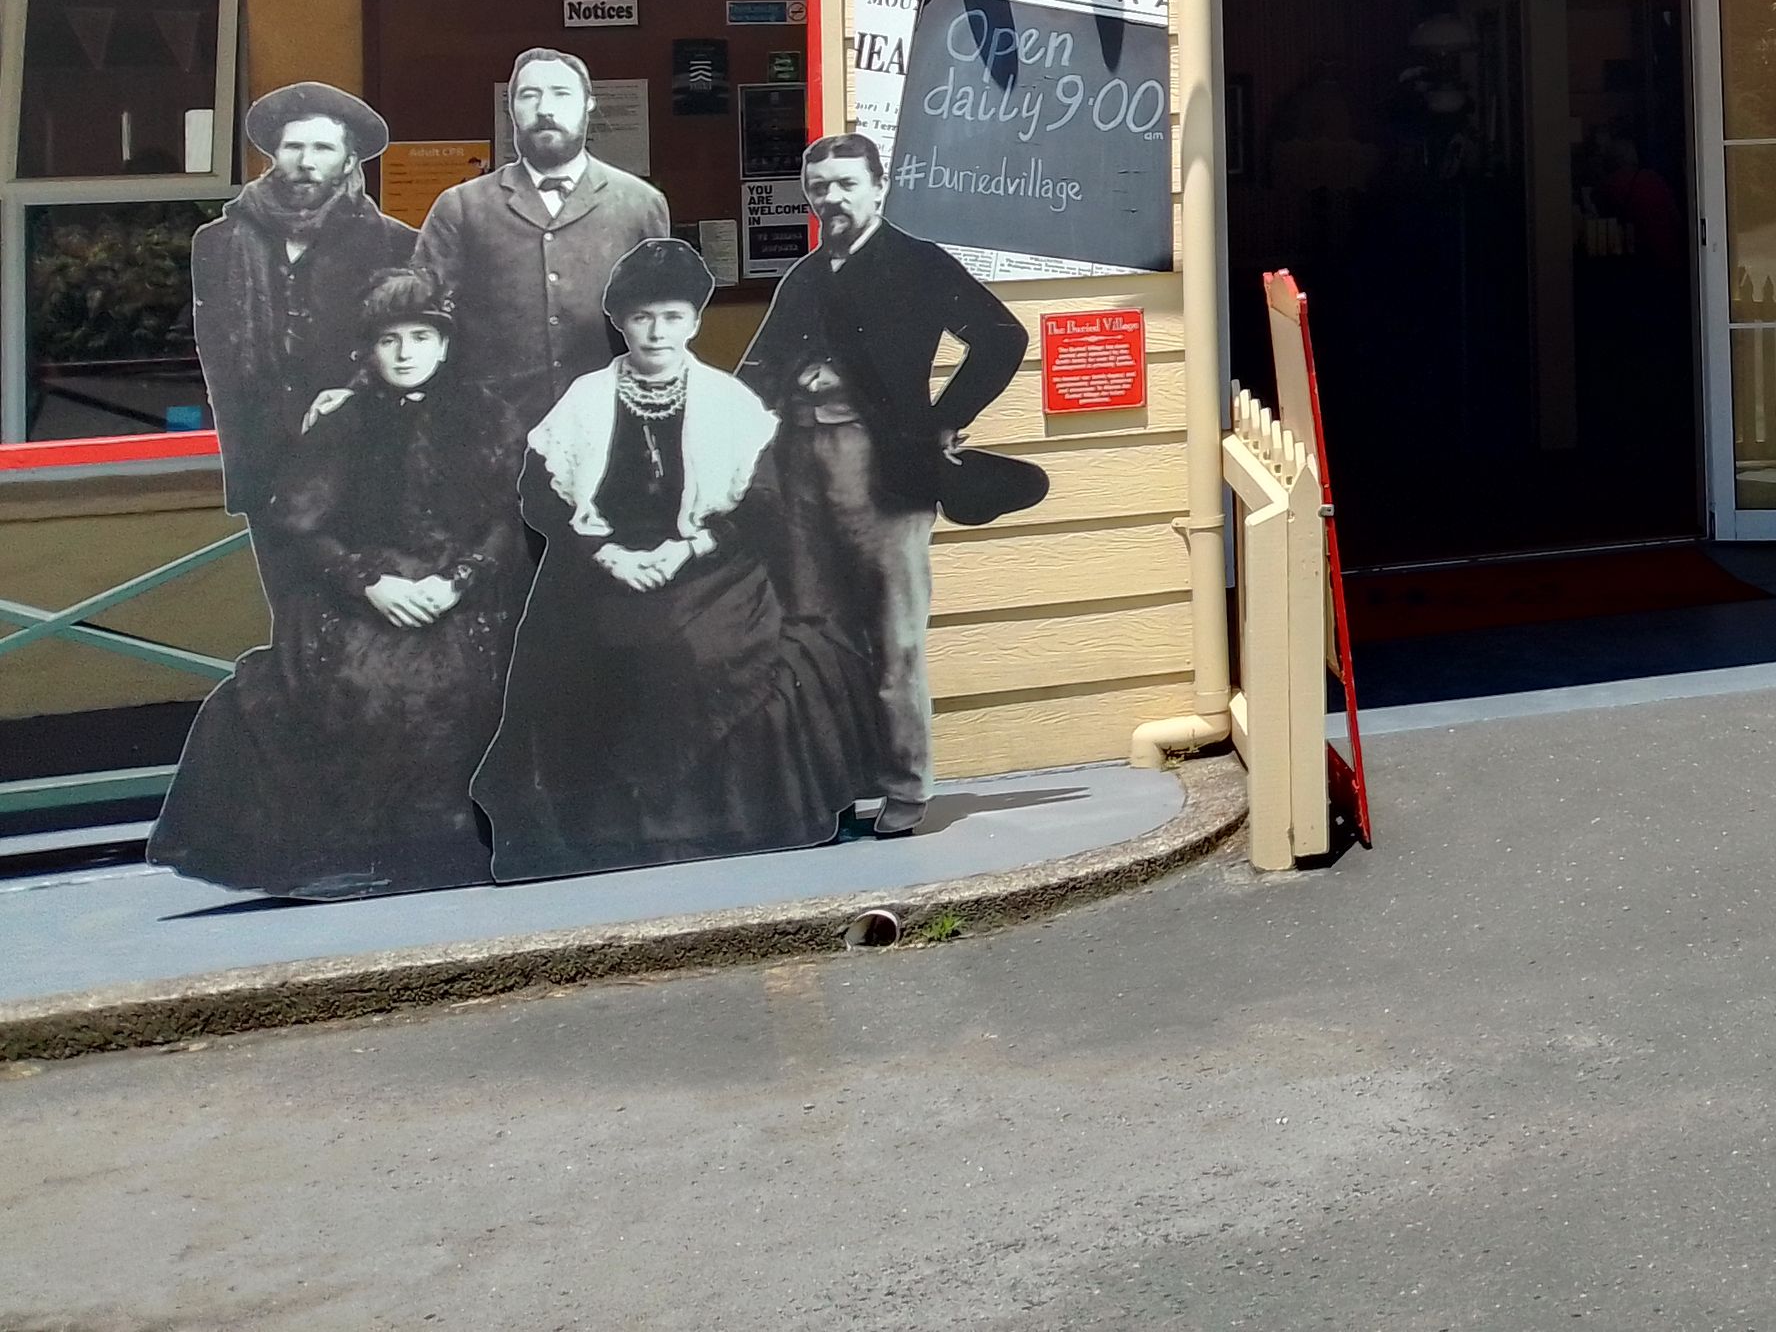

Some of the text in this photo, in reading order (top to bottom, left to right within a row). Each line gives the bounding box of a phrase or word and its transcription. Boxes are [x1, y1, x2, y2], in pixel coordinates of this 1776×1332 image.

[567, 1, 634, 21] Notices
[947, 9, 1074, 83] Open
[923, 67, 1044, 143] daily
[1143, 130, 1165, 141] am
[894, 145, 1083, 212] #buriedvillage
[748, 184, 773, 196] YOU
[748, 195, 774, 206] ARE
[748, 204, 810, 216] WELCOME
[748, 216, 761, 226] IN
[1067, 318, 1100, 334] Buried
[1102, 316, 1140, 332] Village
